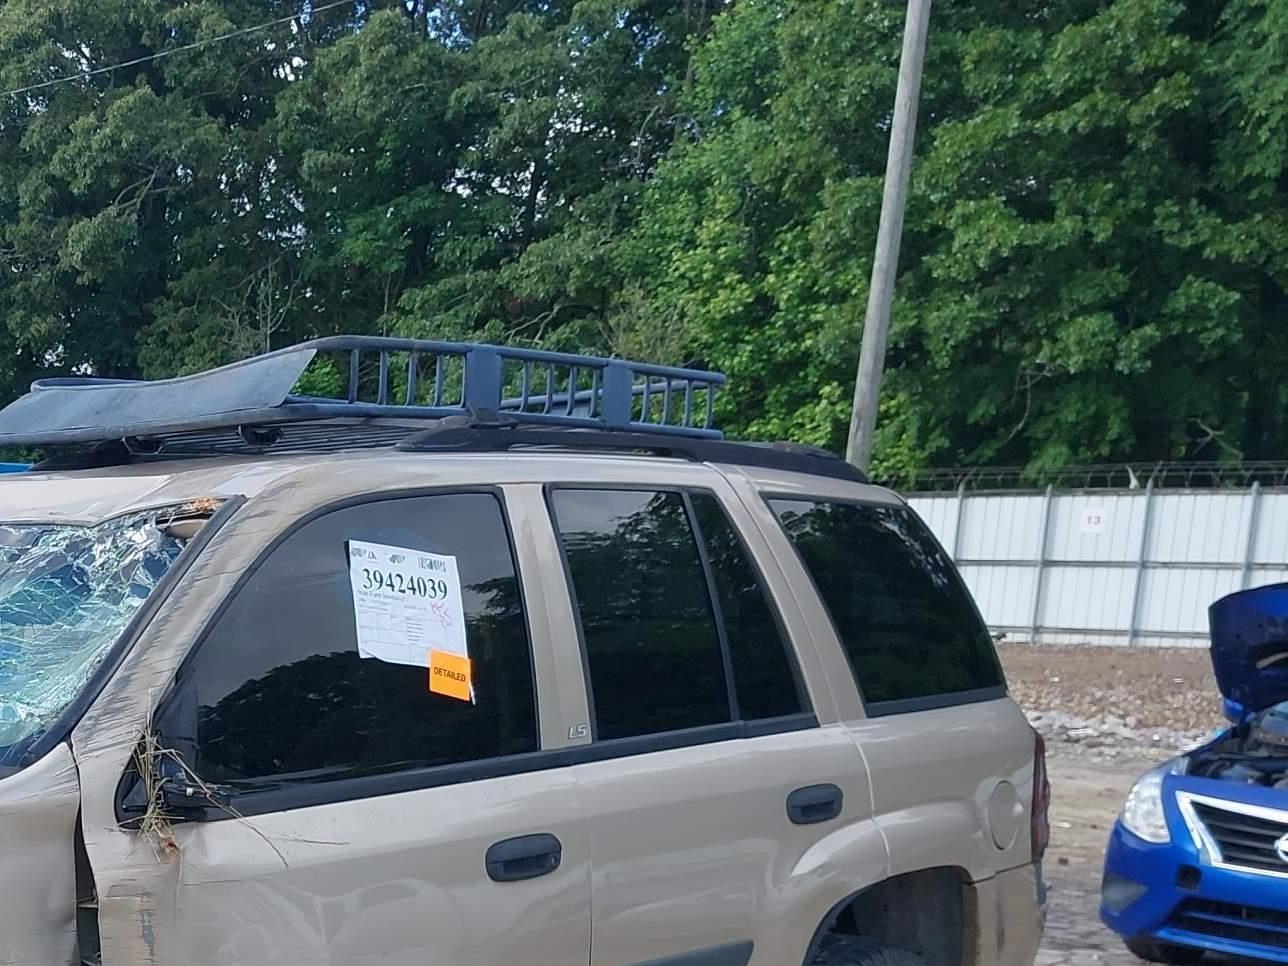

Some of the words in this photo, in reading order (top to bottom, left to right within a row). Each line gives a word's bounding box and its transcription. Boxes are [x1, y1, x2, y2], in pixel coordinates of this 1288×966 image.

[362, 568, 448, 600] 39424039
[433, 666, 466, 682] DETAILED
[568, 724, 588, 740] LS
